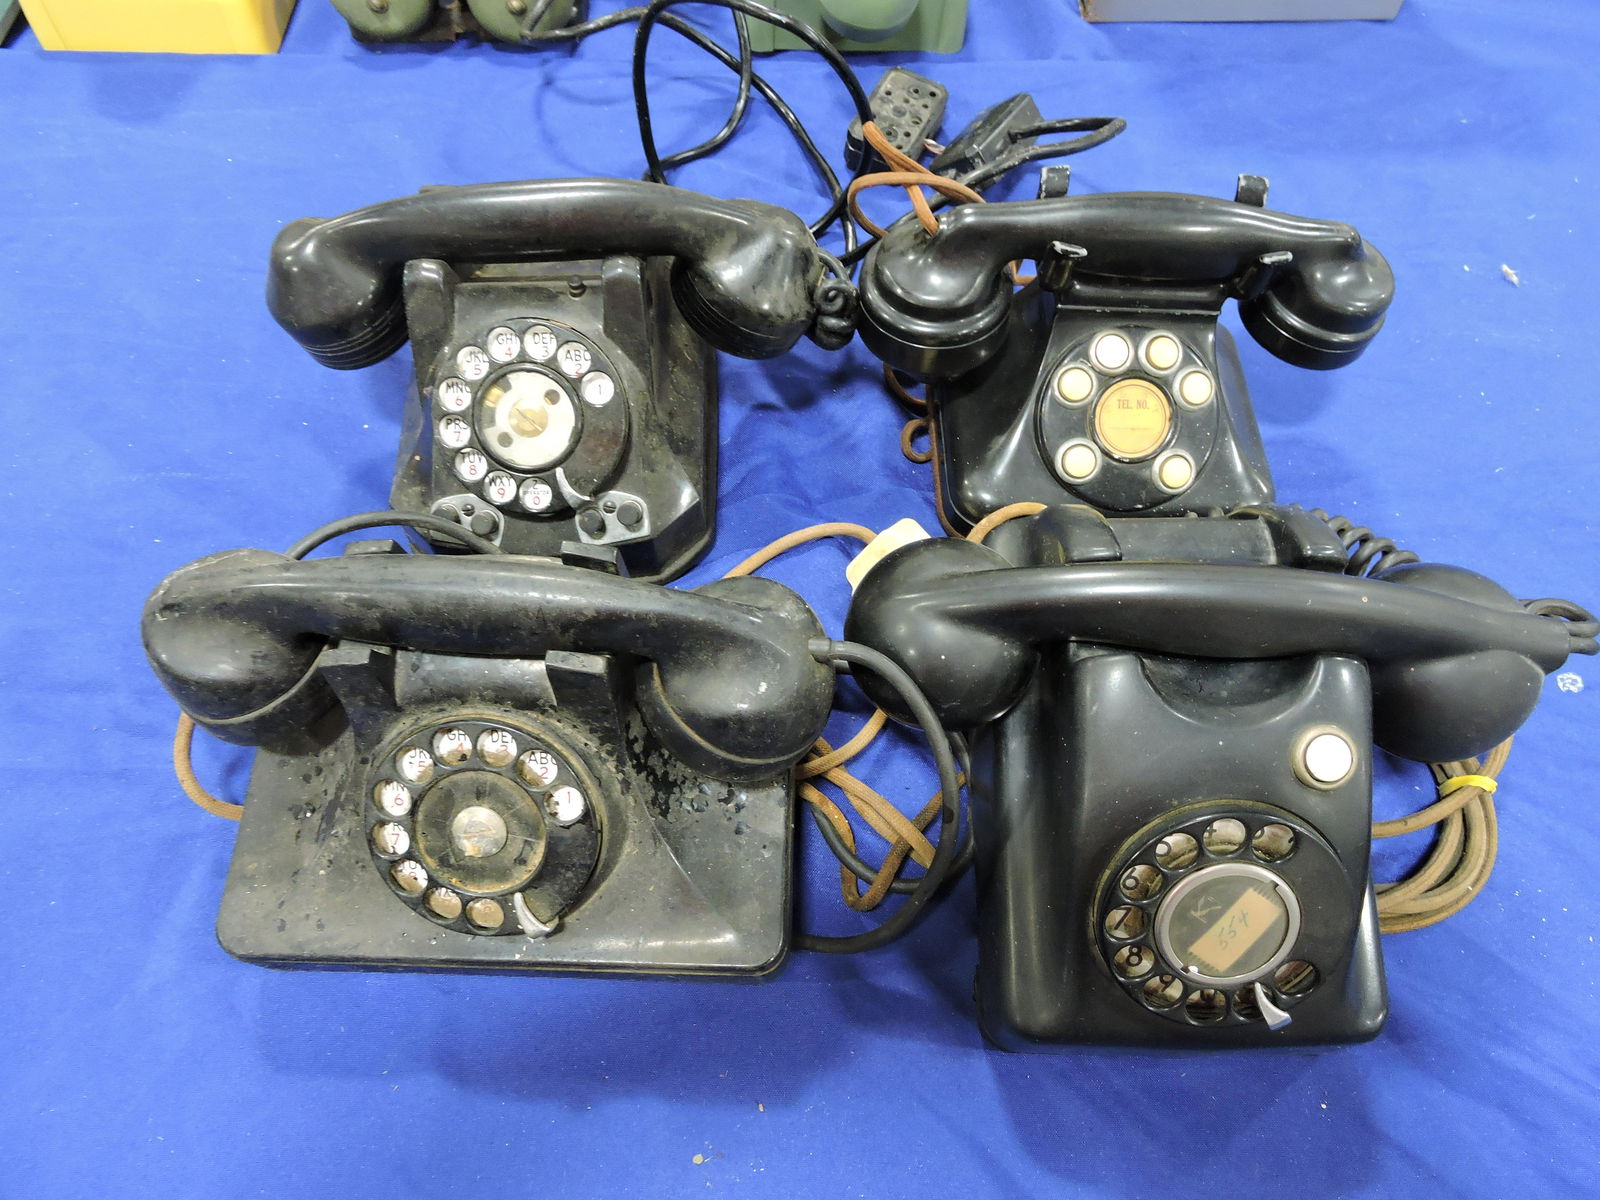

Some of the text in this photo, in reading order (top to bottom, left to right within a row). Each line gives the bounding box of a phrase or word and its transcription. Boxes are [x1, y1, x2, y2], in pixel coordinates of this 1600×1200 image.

[504, 347, 513, 357] 4
[541, 345, 550, 358] 3
[473, 364, 482, 376] 5
[575, 363, 584, 376] 2
[455, 395, 464, 407] 6
[1136, 399, 1149, 409] NO.
[454, 430, 461, 442] 7
[469, 464, 477, 476] 8
[497, 487, 506, 499] 9
[532, 496, 540, 506] 0
[539, 766, 550, 780] 2
[394, 793, 404, 806] 6
[390, 832, 400, 846] 7
[1122, 867, 1139, 891] 6
[1113, 906, 1131, 930] 7
[1125, 944, 1143, 967] 8
[1159, 974, 1176, 993] 9
